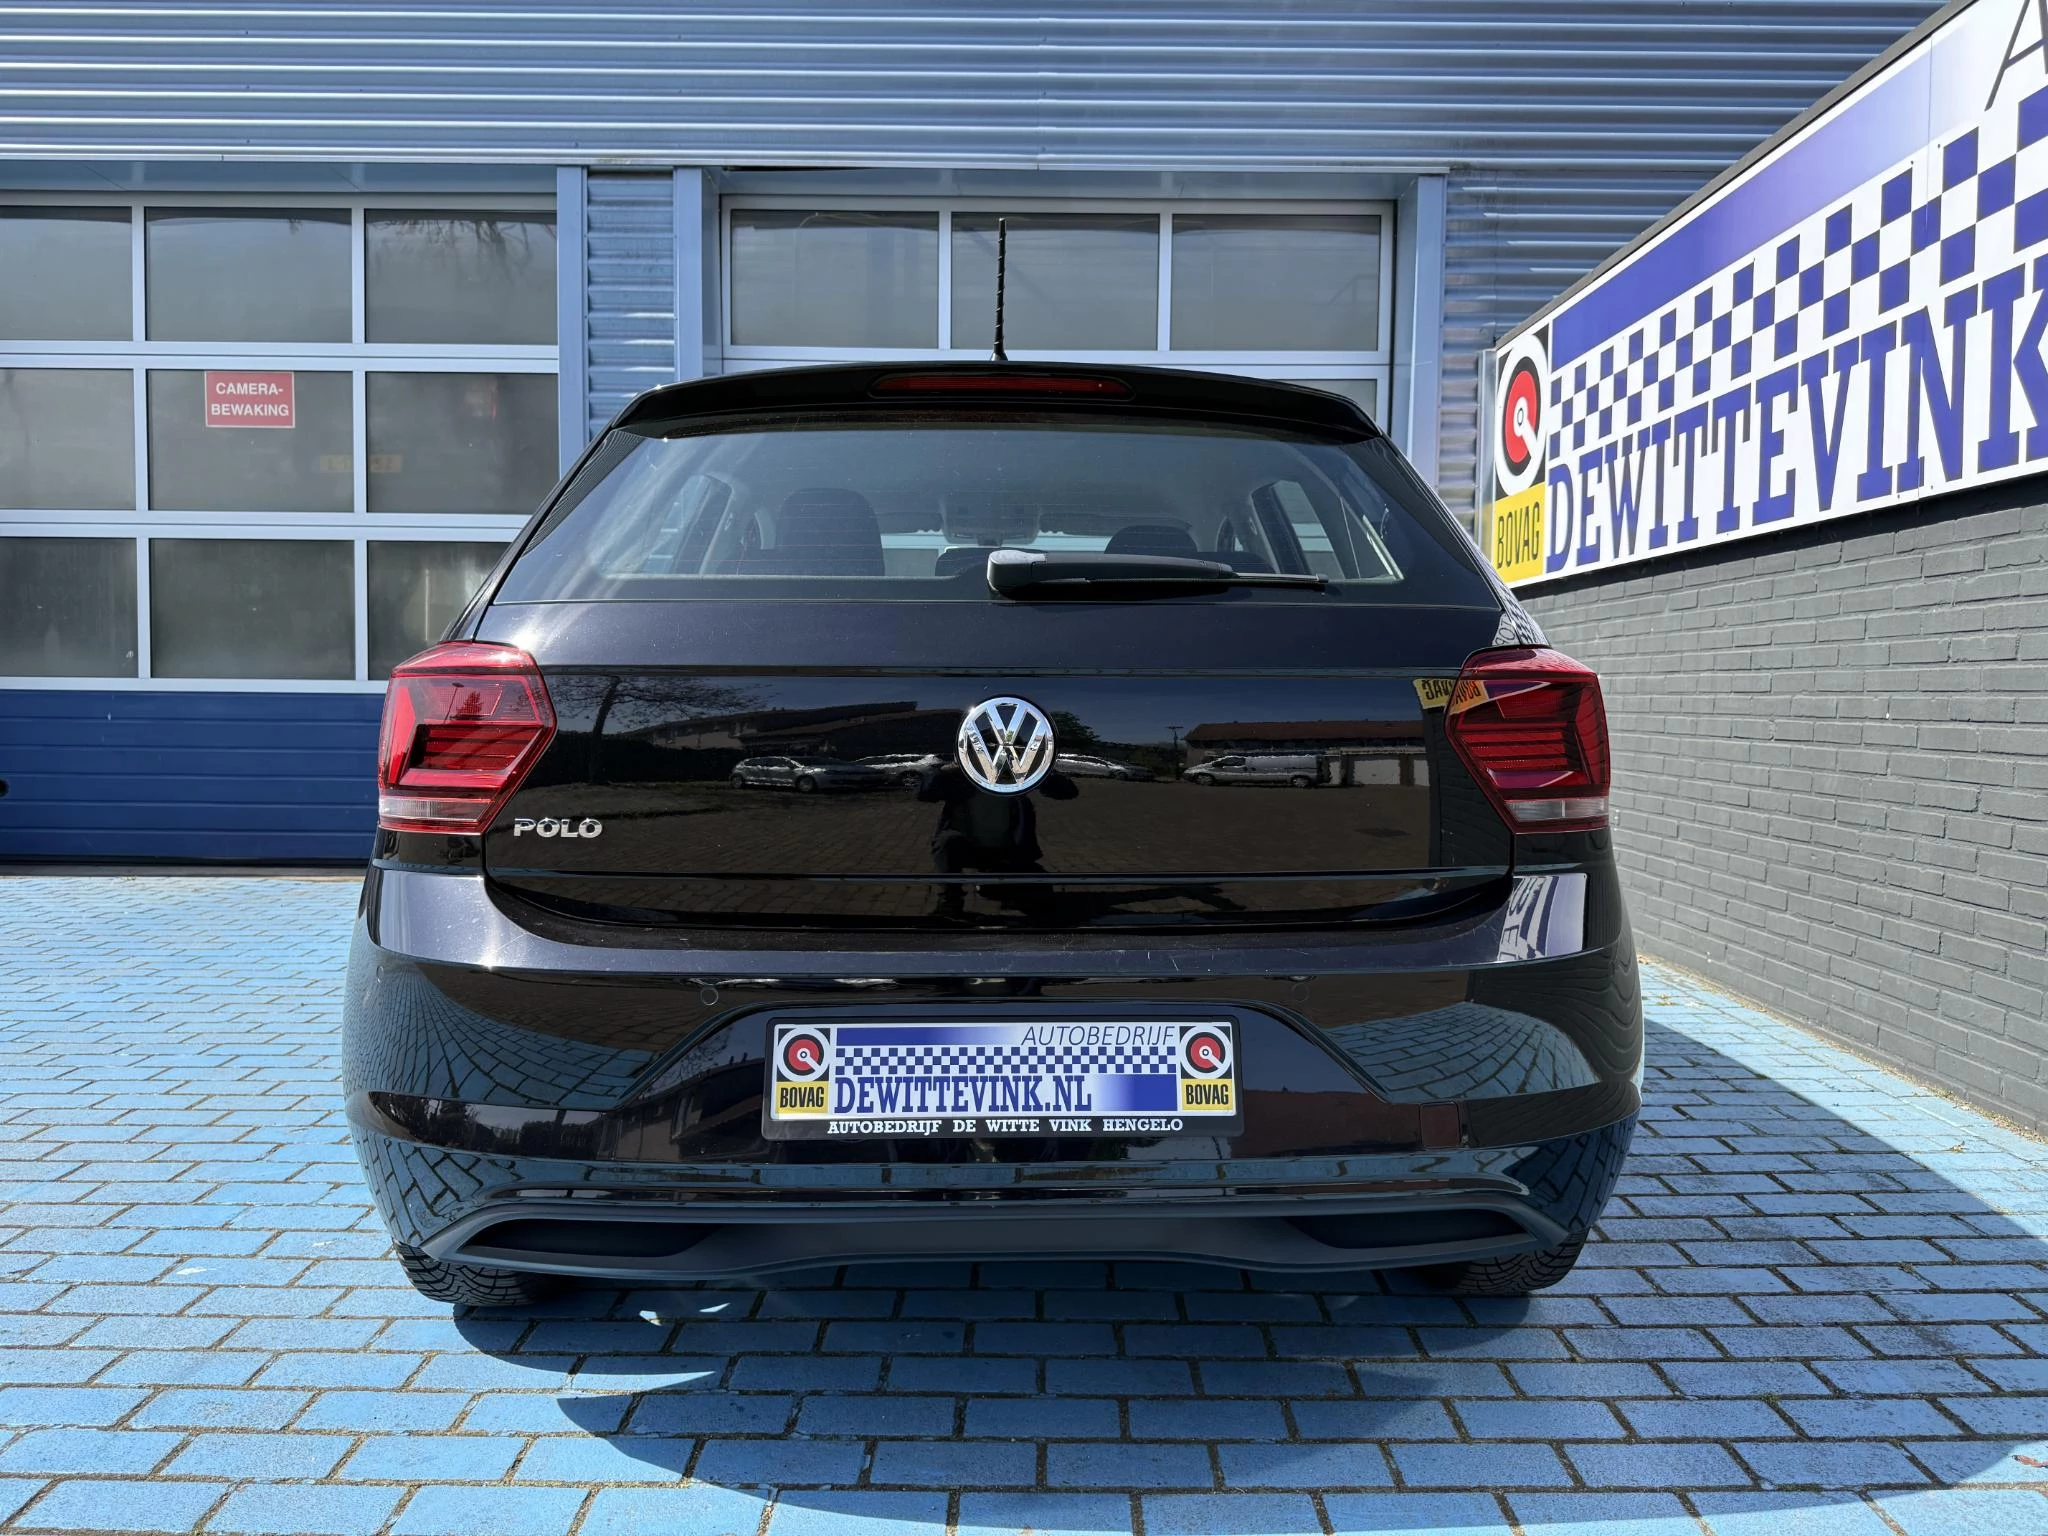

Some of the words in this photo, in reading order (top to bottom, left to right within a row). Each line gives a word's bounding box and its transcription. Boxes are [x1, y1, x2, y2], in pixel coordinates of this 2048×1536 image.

[216, 383, 284, 395] CAMERA-
[211, 404, 289, 416] BEWAKING
[1497, 501, 1540, 569] BOVAG
[513, 817, 603, 838] POLO
[1021, 1025, 1175, 1046] AUTOBEDRIJF
[780, 1086, 825, 1109] BOVAG
[834, 1075, 1092, 1113] DEWITTEVINK.NL
[1186, 1083, 1229, 1105] BOVAG
[827, 1119, 942, 1136] AUTOBEDRIJF
[953, 1119, 977, 1133] DE
[986, 1119, 1040, 1132] WITTE
[1049, 1119, 1092, 1132] VINK
[1102, 1118, 1183, 1132] HENGELO
